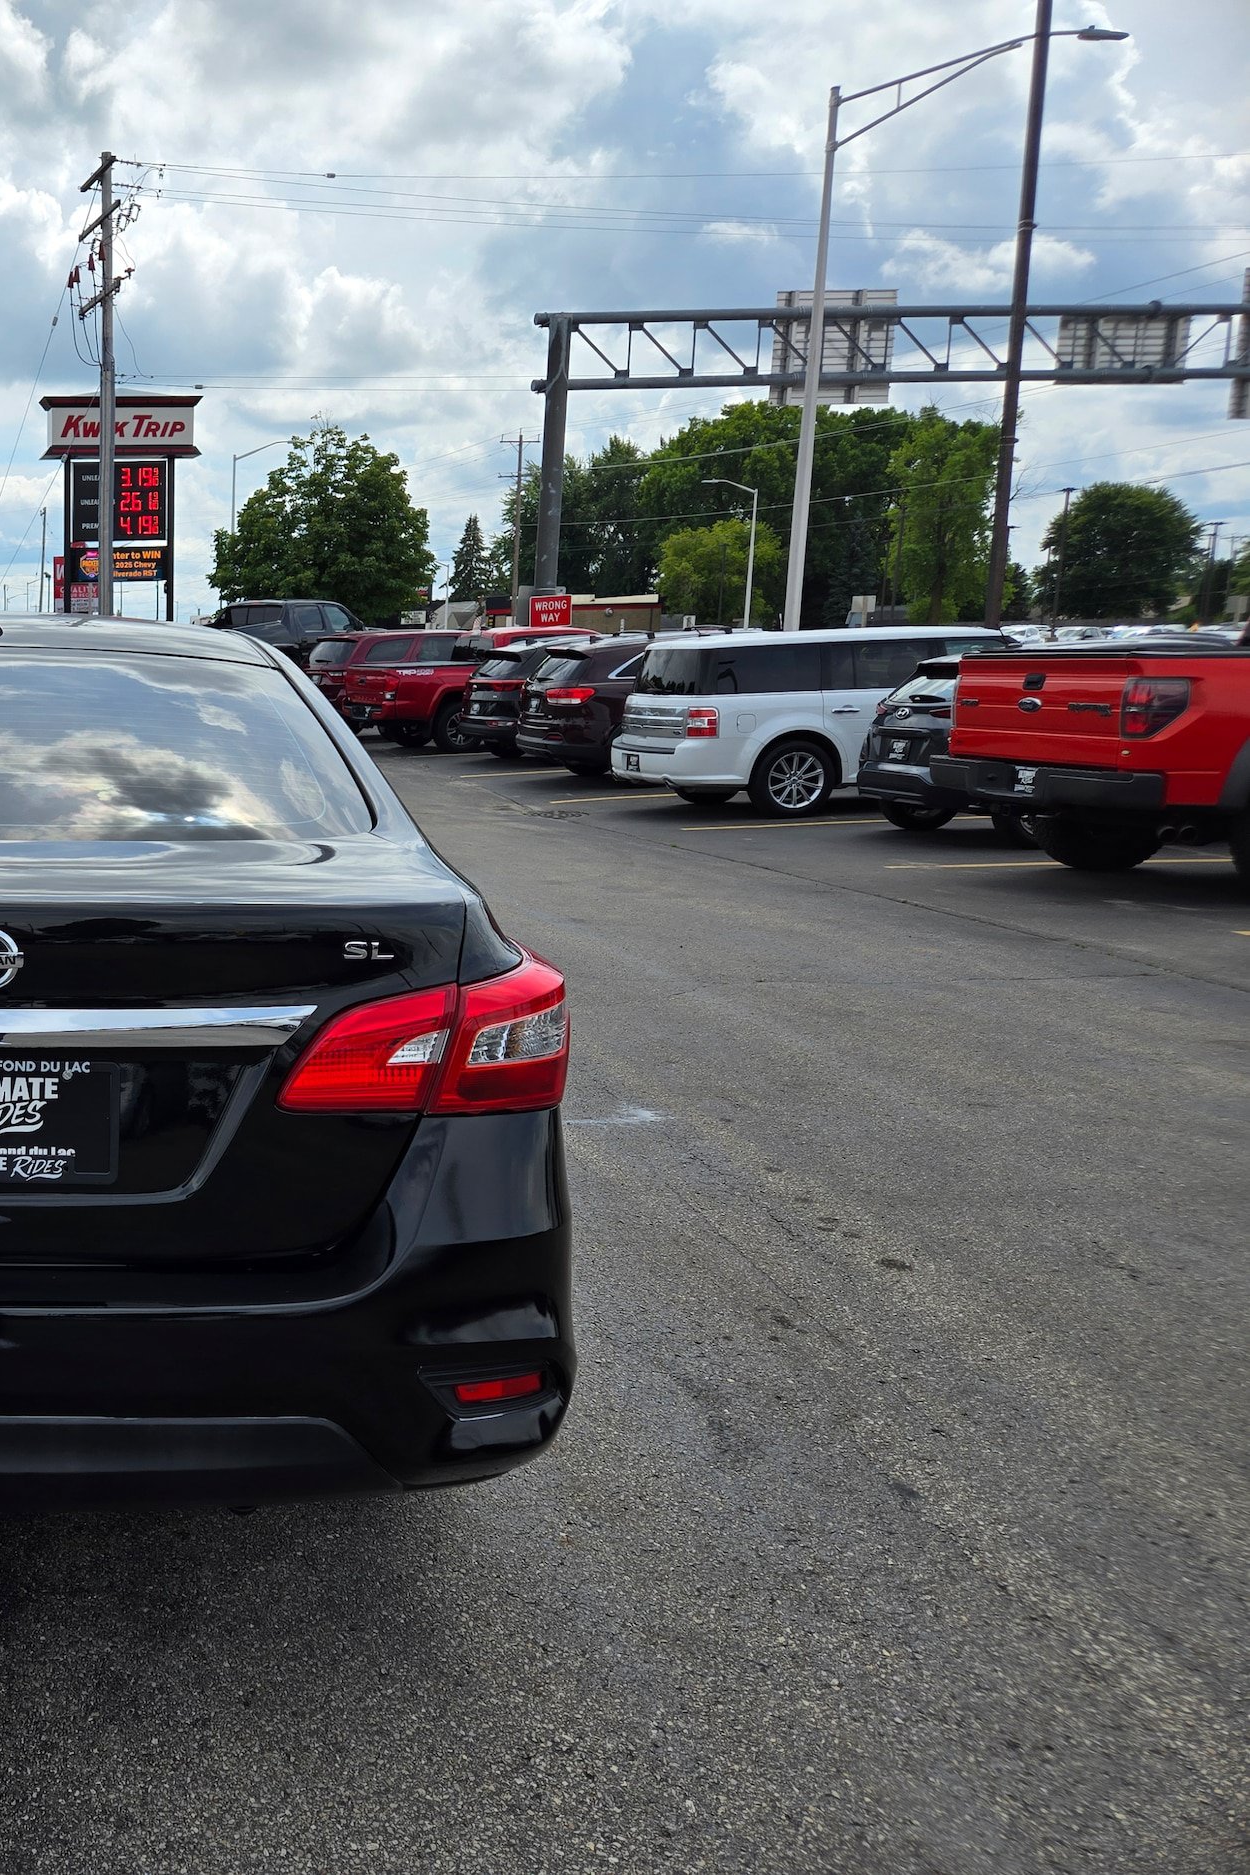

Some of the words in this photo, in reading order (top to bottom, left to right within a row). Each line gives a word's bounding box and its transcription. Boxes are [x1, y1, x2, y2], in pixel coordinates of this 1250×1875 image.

[60, 414, 130, 438] KWK
[132, 414, 186, 438] TRIP
[131, 551, 141, 560] to
[142, 550, 161, 559] WIN
[134, 561, 156, 570] Chevy
[143, 569, 157, 577] RST
[535, 600, 567, 611] WRONG
[541, 612, 560, 622] WAY
[343, 941, 394, 960] SL
[40, 1061, 60, 1073] DU
[65, 1062, 91, 1074] LAC
